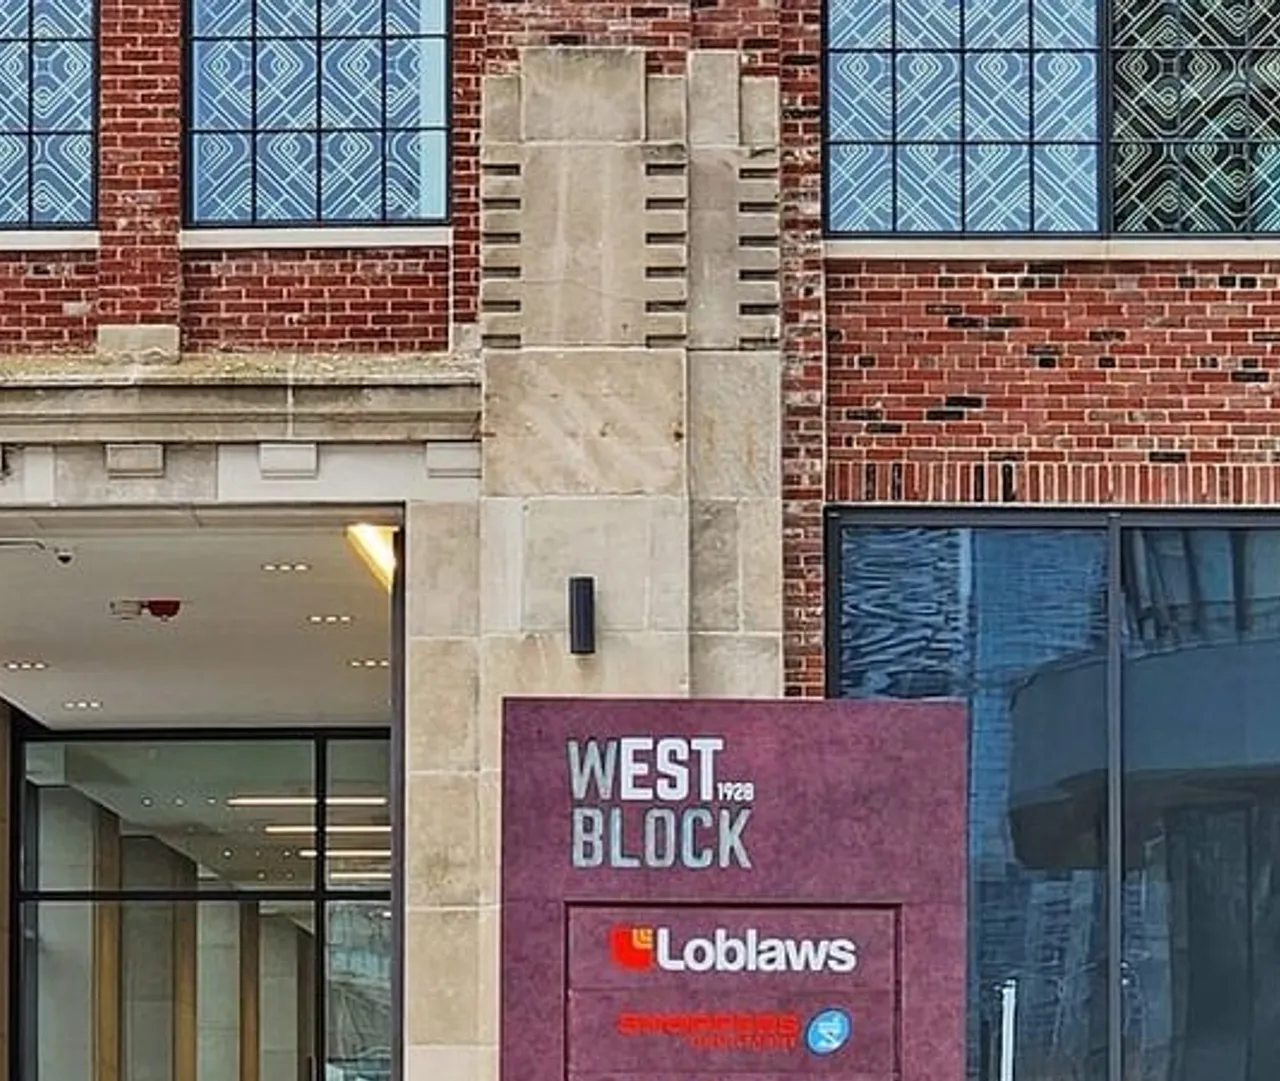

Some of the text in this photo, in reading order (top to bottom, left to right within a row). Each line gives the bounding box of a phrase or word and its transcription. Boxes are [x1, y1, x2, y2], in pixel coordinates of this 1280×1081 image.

[568, 737, 754, 801] WEST 1928
[572, 808, 752, 868] BLOCK
[656, 928, 858, 971] Loblaws
